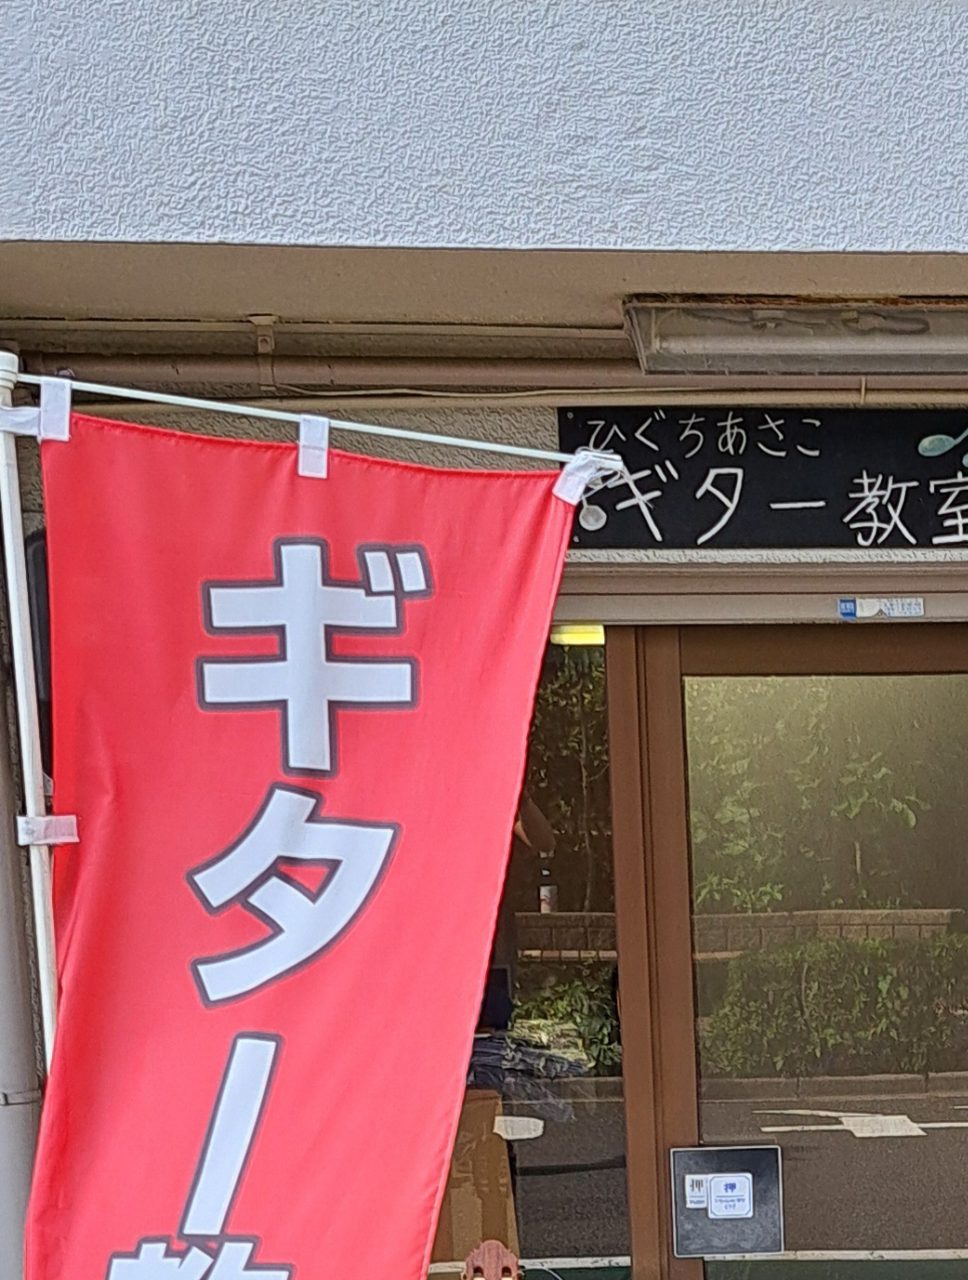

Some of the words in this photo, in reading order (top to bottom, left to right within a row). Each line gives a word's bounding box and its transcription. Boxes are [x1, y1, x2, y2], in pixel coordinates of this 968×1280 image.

[586, 409, 822, 459] ひぐちあさこ
